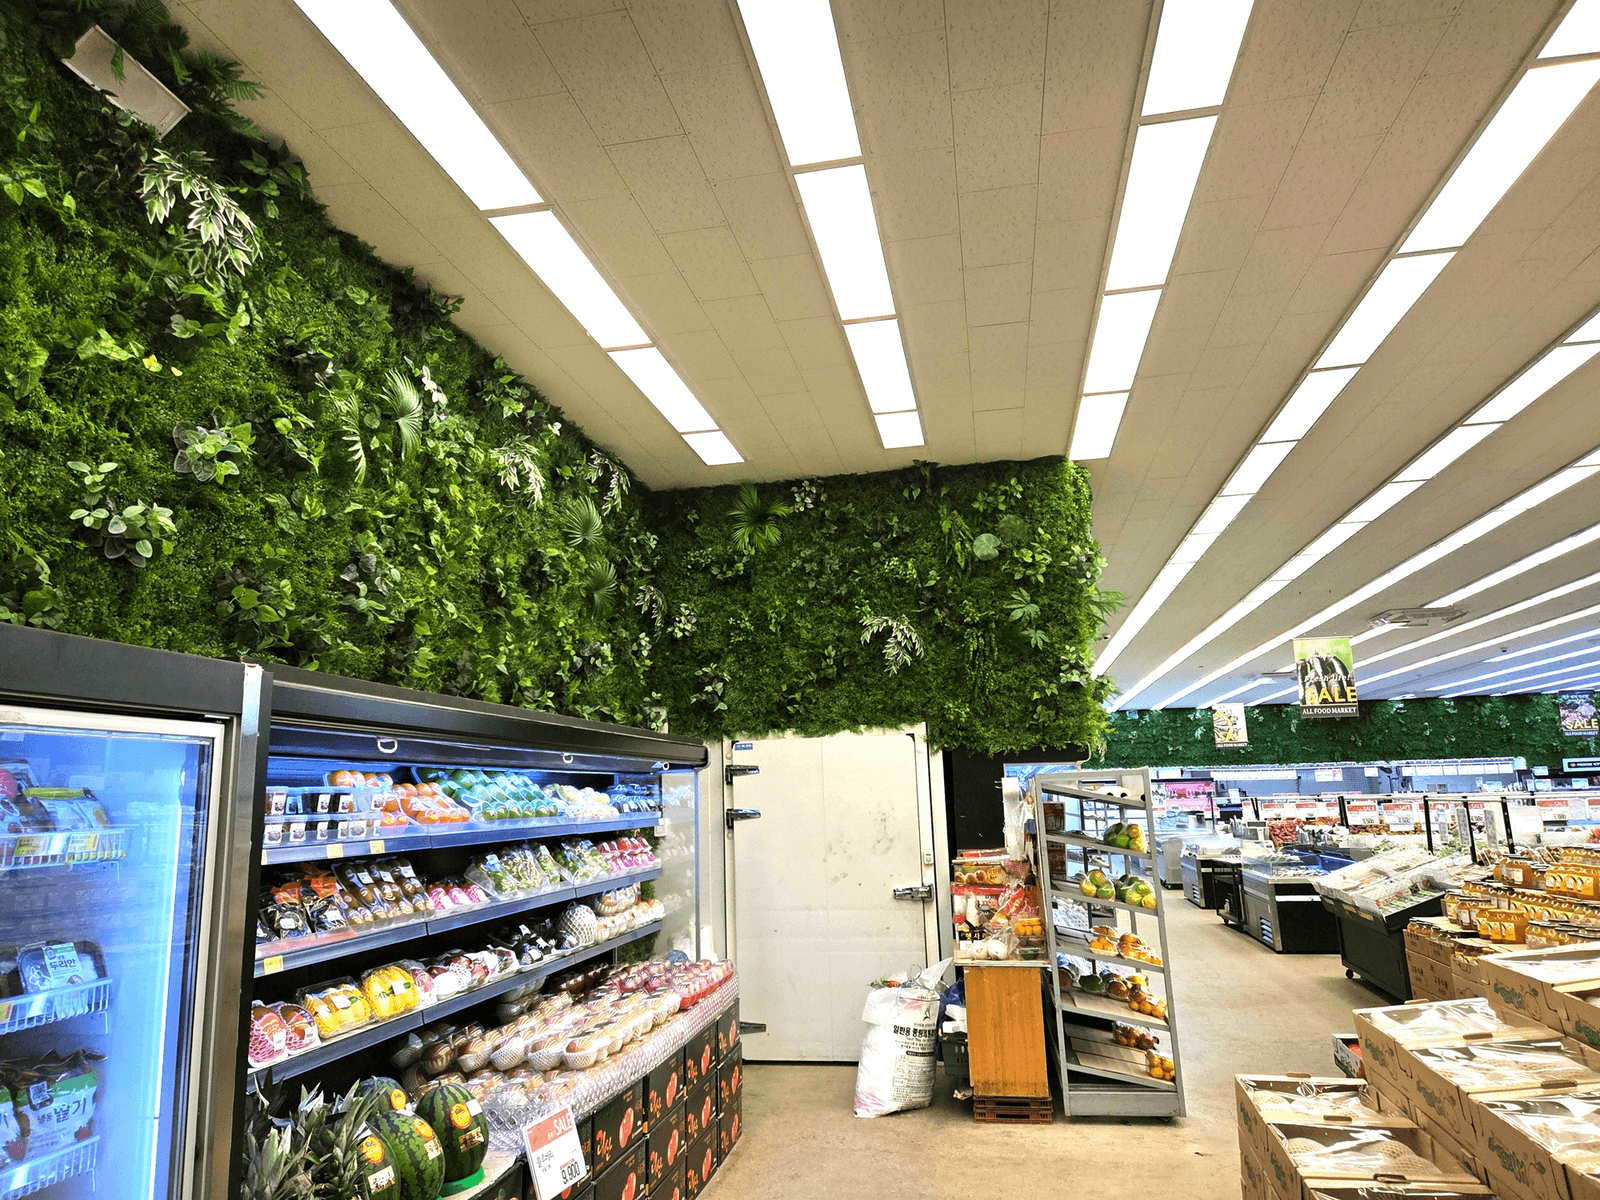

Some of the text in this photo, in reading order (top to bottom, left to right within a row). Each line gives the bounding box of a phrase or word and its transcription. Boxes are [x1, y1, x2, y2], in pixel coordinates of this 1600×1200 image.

[1305, 686, 1358, 704] SALE
[1314, 707, 1332, 715] FOOD
[1332, 706, 1357, 714] MARKET
[1566, 718, 1599, 730] SALE
[49, 958, 77, 971] 두리안
[893, 1024, 912, 1037] 일반용
[54, 1097, 87, 1124] 딸기
[553, 1112, 574, 1136] SALE
[561, 1161, 581, 1185] 9,900
